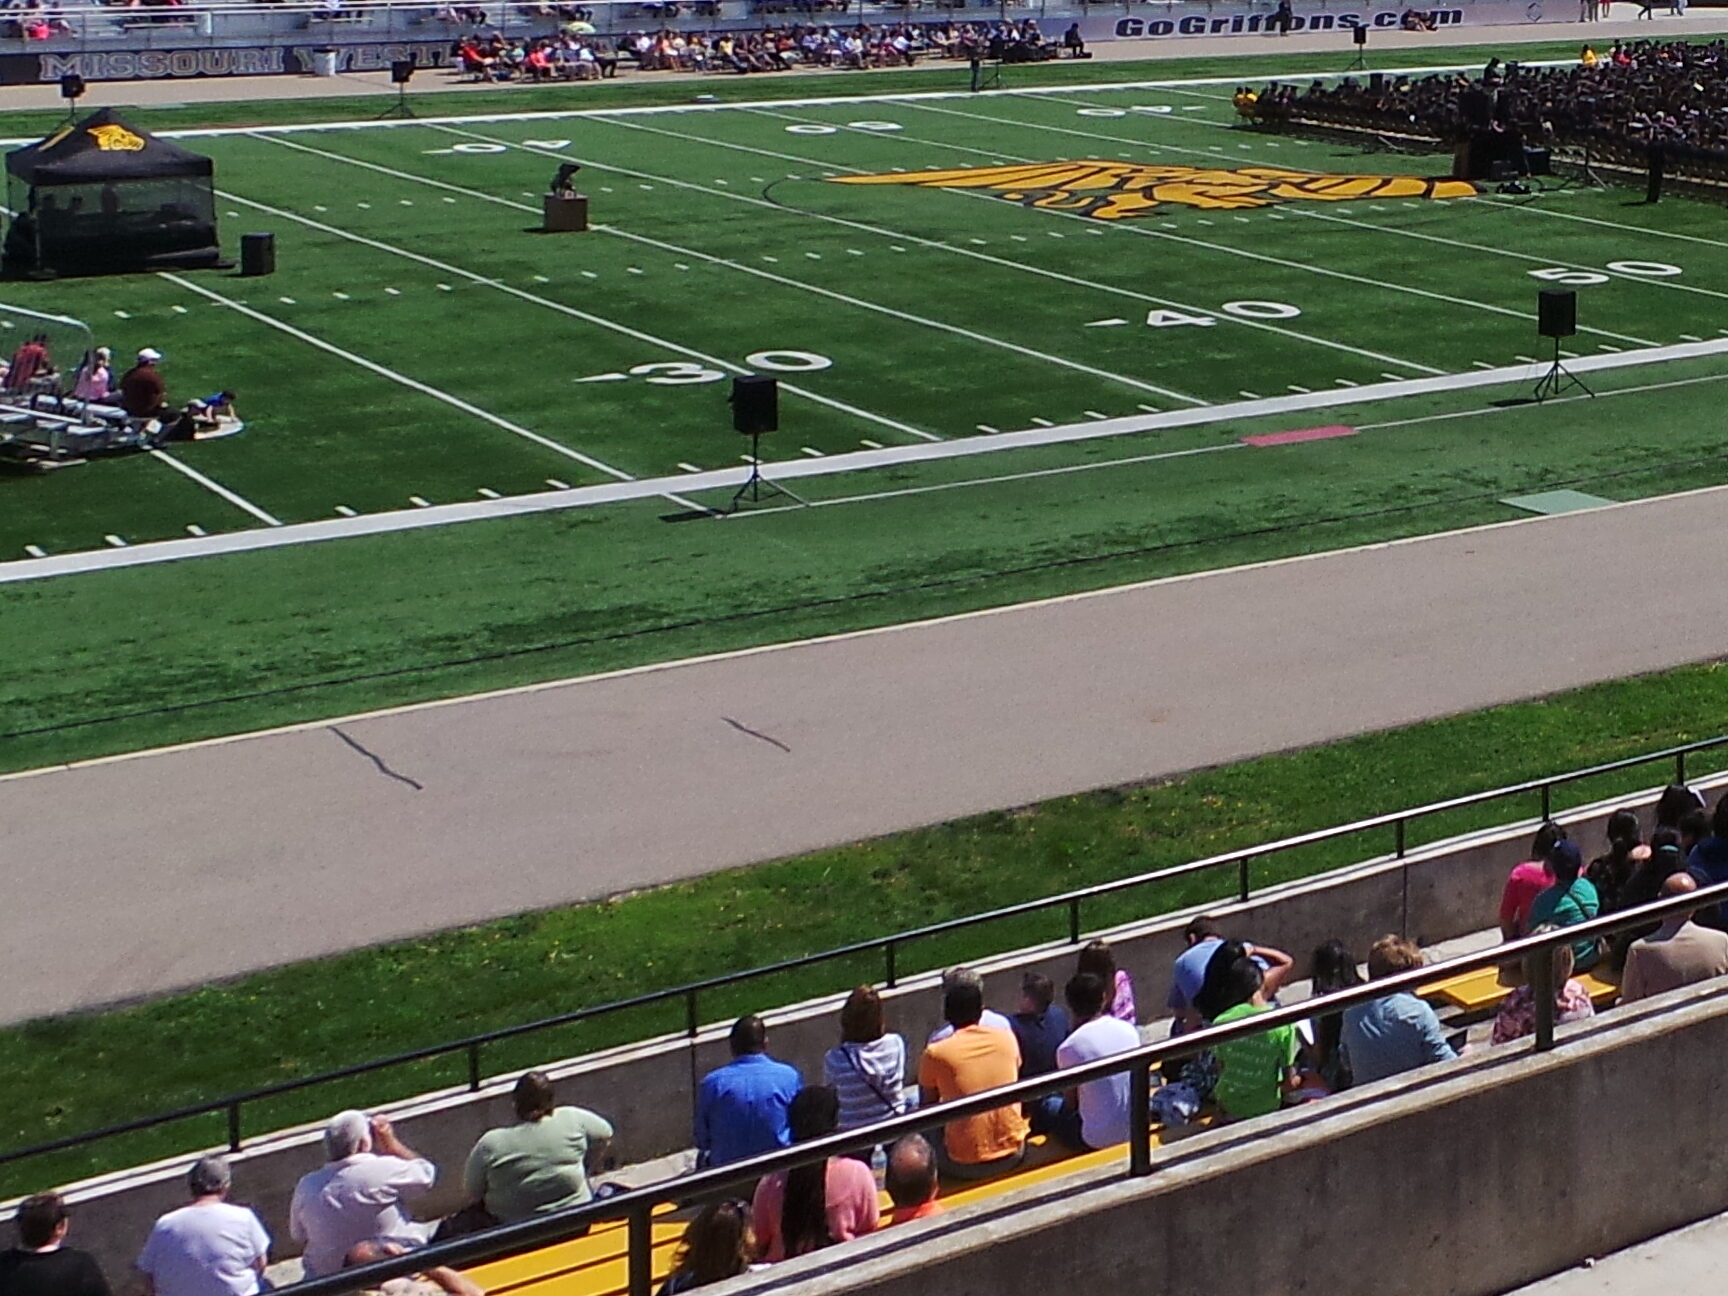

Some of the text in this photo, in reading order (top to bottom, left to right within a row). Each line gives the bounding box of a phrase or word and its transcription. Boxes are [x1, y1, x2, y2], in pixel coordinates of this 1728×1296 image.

[40, 46, 284, 81] MISSOURI
[1527, 261, 1682, 284] 50
[1147, 301, 1301, 326] 40
[629, 350, 832, 384] 30
